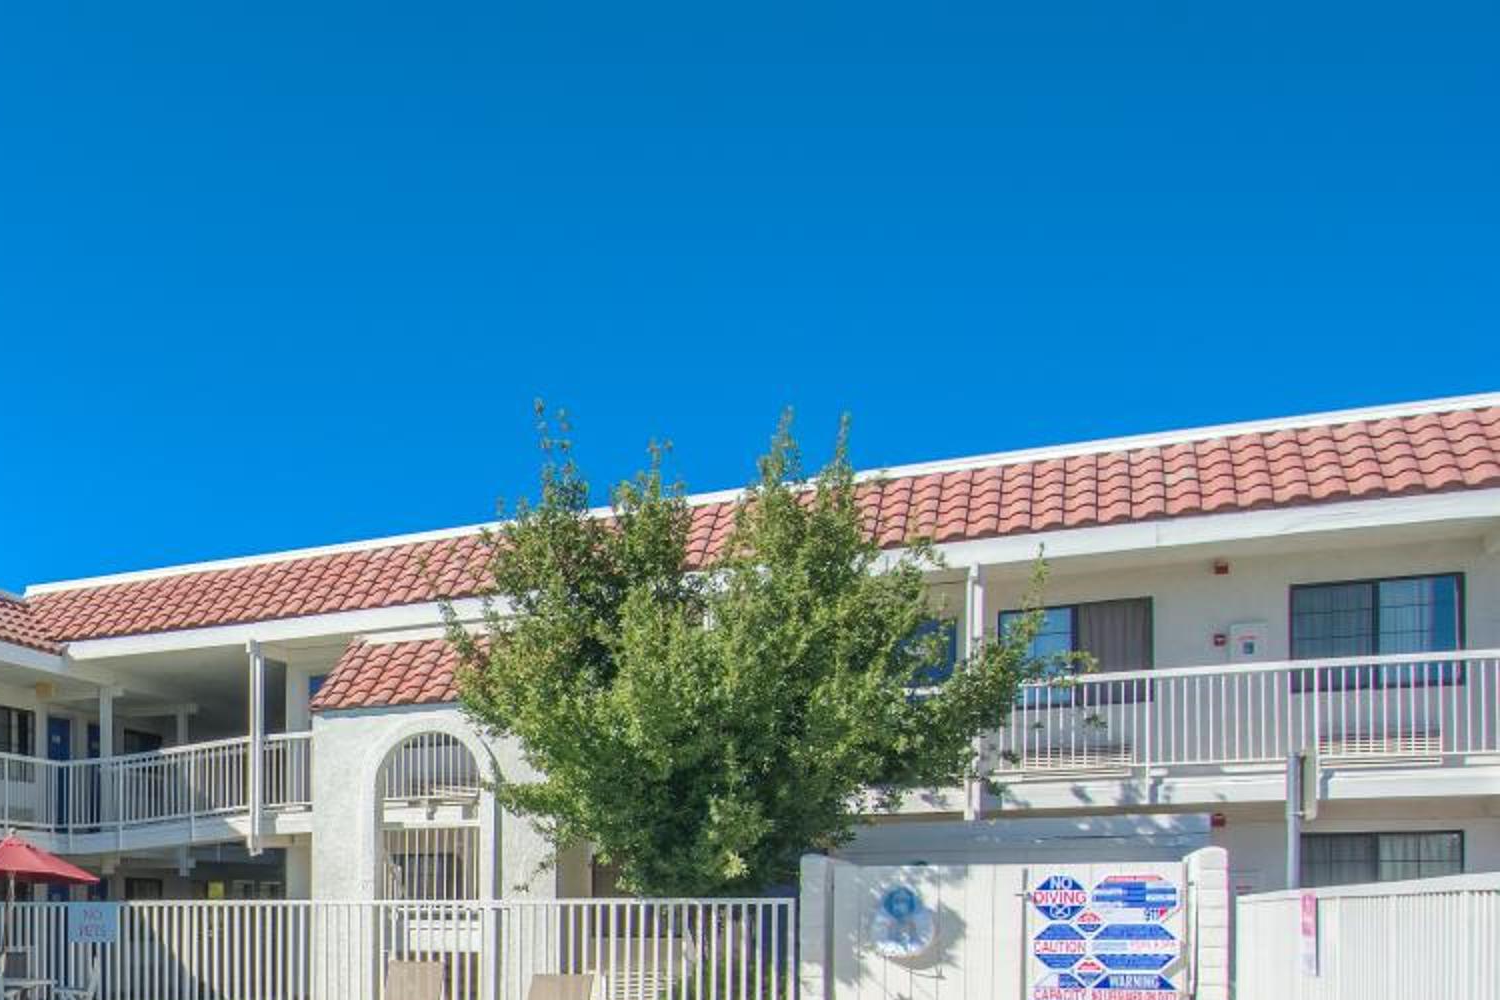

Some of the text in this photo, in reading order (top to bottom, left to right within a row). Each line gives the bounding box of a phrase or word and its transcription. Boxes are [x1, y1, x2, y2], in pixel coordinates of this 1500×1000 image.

[1050, 876, 1073, 889] NO
[1033, 891, 1087, 904] DIVING
[1033, 941, 1087, 953] CAUTION
[1110, 975, 1160, 988] WARNING
[1033, 988, 1088, 1000] CAPACITY
